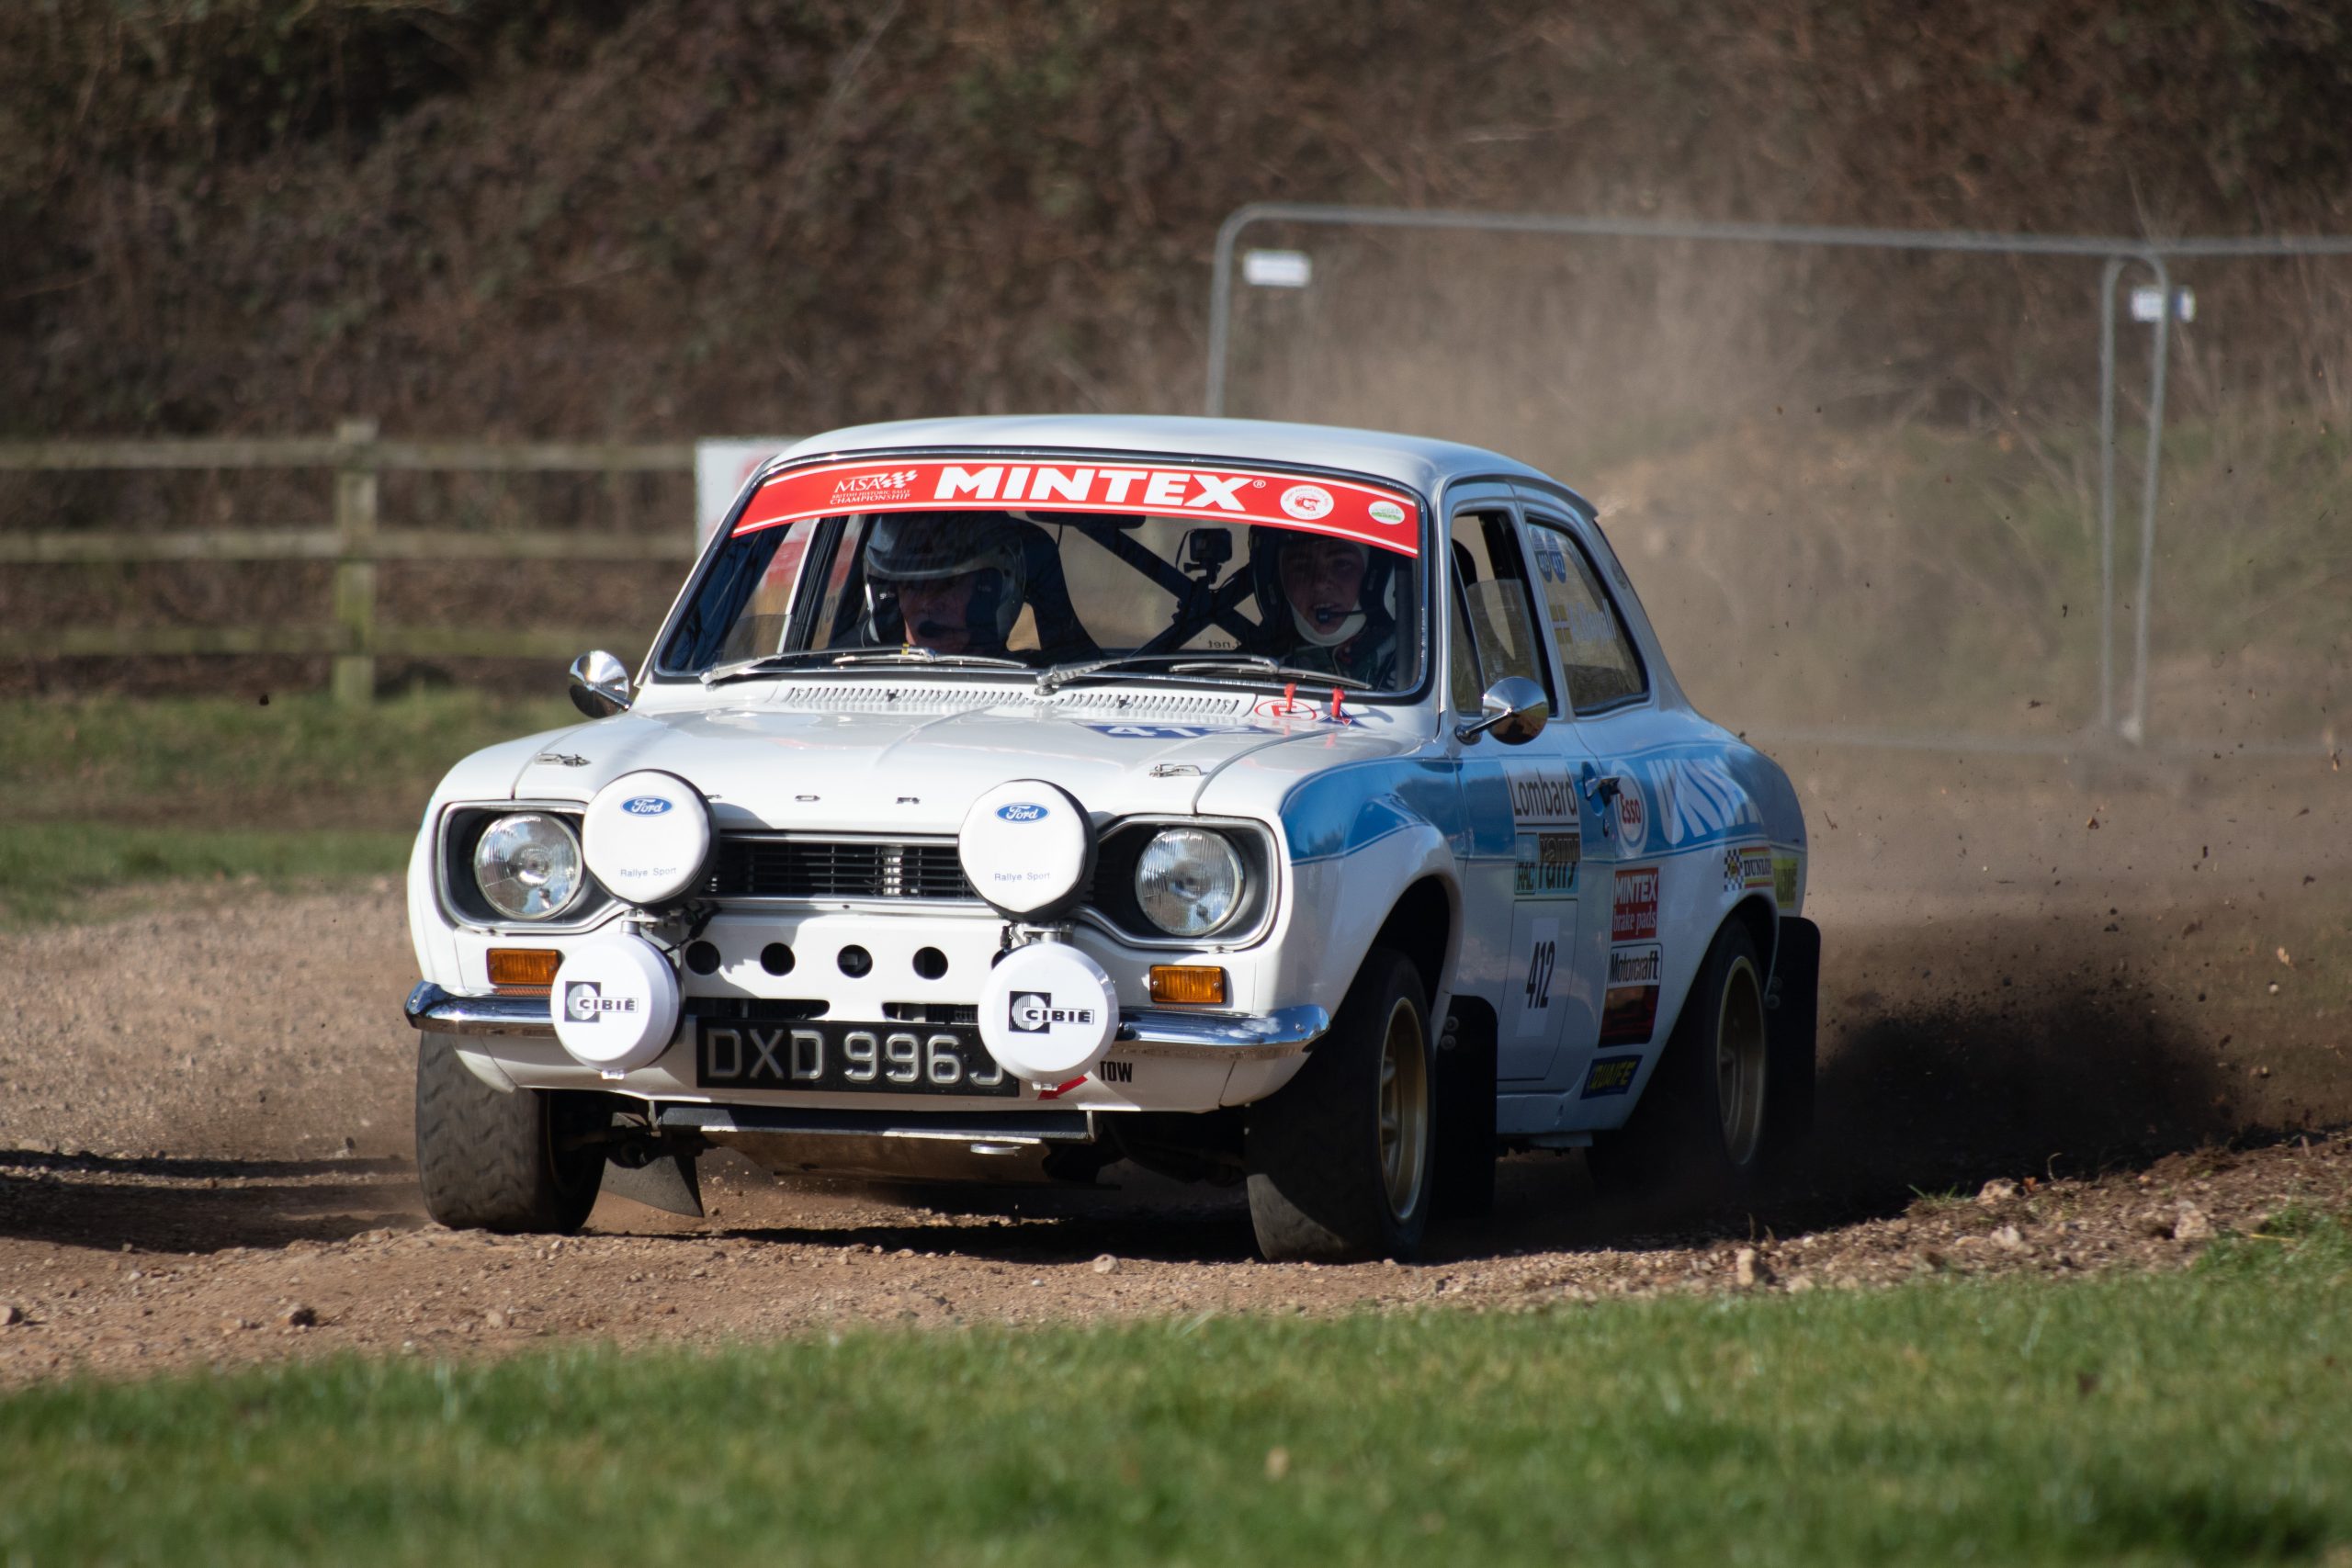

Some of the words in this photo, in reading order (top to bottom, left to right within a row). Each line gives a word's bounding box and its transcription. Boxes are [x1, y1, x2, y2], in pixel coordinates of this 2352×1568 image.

[830, 493, 910, 505] CHAMPIONSHIP
[834, 478, 881, 493] MSA
[933, 466, 1253, 512] MINTEX
[631, 797, 663, 813] Ford
[1506, 767, 1577, 817] Lombard
[1006, 804, 1038, 820] Ford
[1620, 793, 1641, 824] Esso
[620, 868, 648, 878] Rallye
[652, 866, 677, 877] Sport
[994, 873, 1022, 883] Rallye
[1026, 871, 1050, 882] Sport
[1615, 874, 1657, 905] MINTEX
[1613, 906, 1634, 932] brake
[1636, 904, 1657, 935] pads
[1525, 941, 1555, 1009] 412
[1609, 950, 1659, 984] Motorcraft
[707, 1027, 824, 1081] DXD
[1100, 1060, 1133, 1083] TOW
